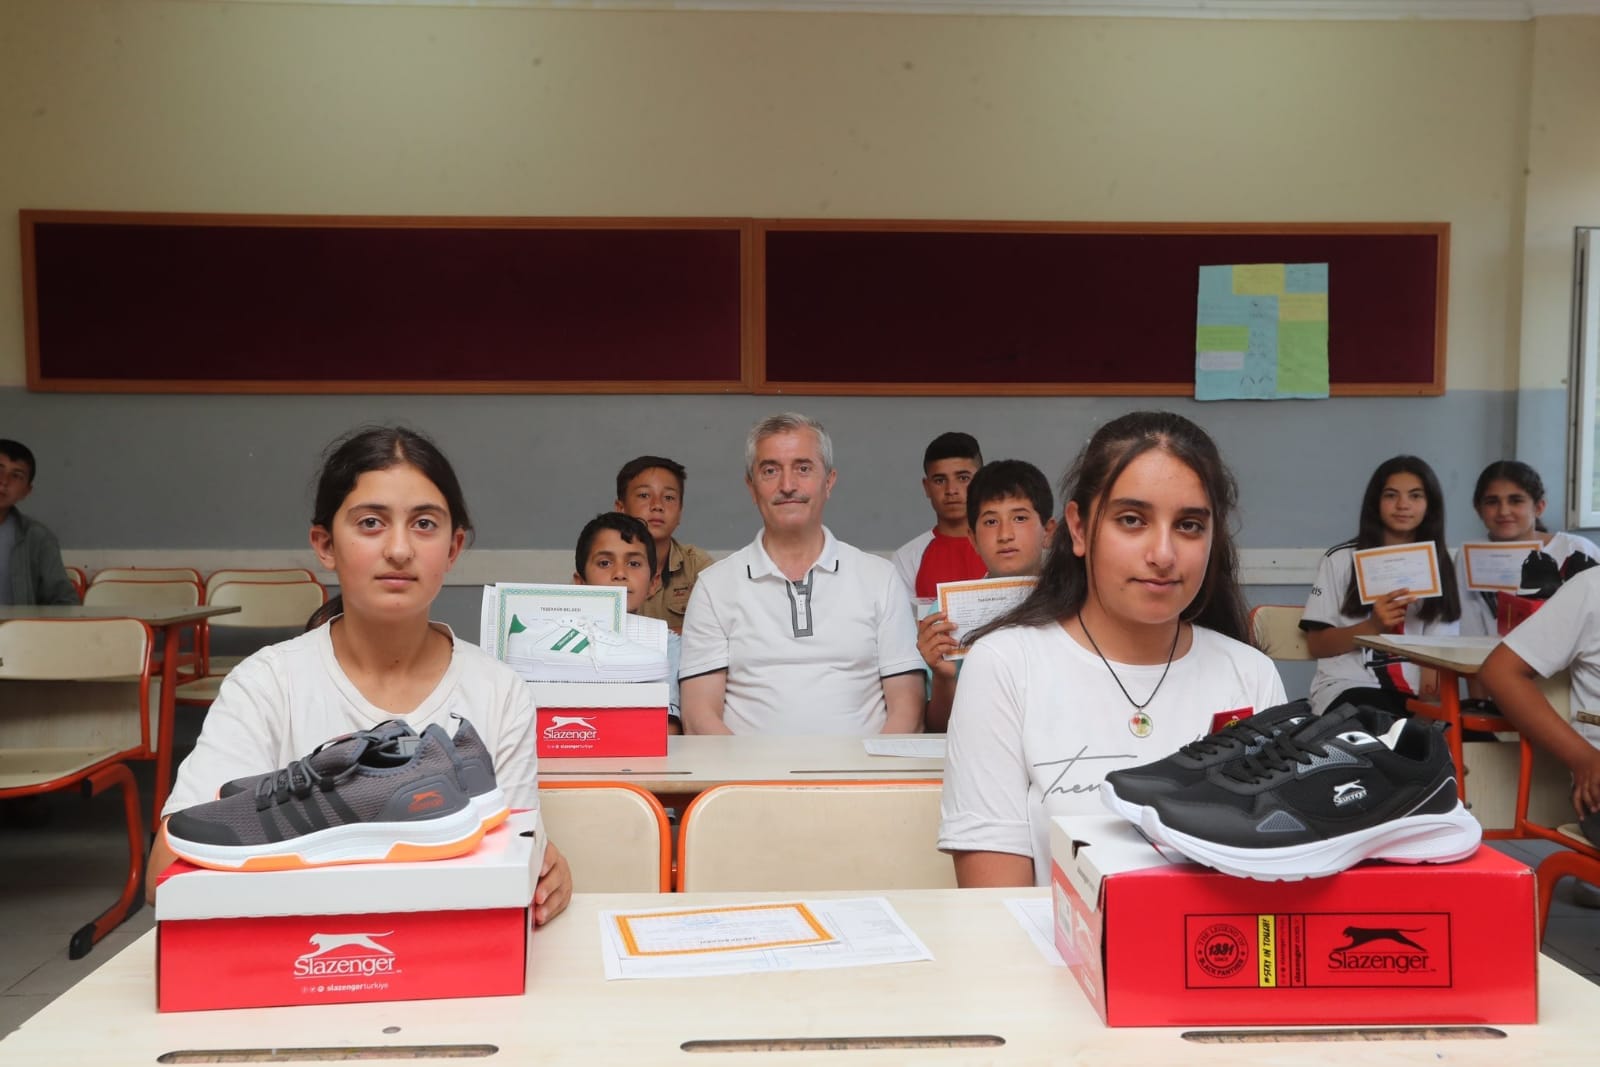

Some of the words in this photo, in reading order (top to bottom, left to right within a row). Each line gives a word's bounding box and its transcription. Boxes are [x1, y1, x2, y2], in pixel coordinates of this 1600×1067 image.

[543, 729, 598, 742] Slazenger
[1262, 948, 1272, 958] IN
[293, 957, 396, 977] Slazenger
[1327, 951, 1430, 975] Slazenger
